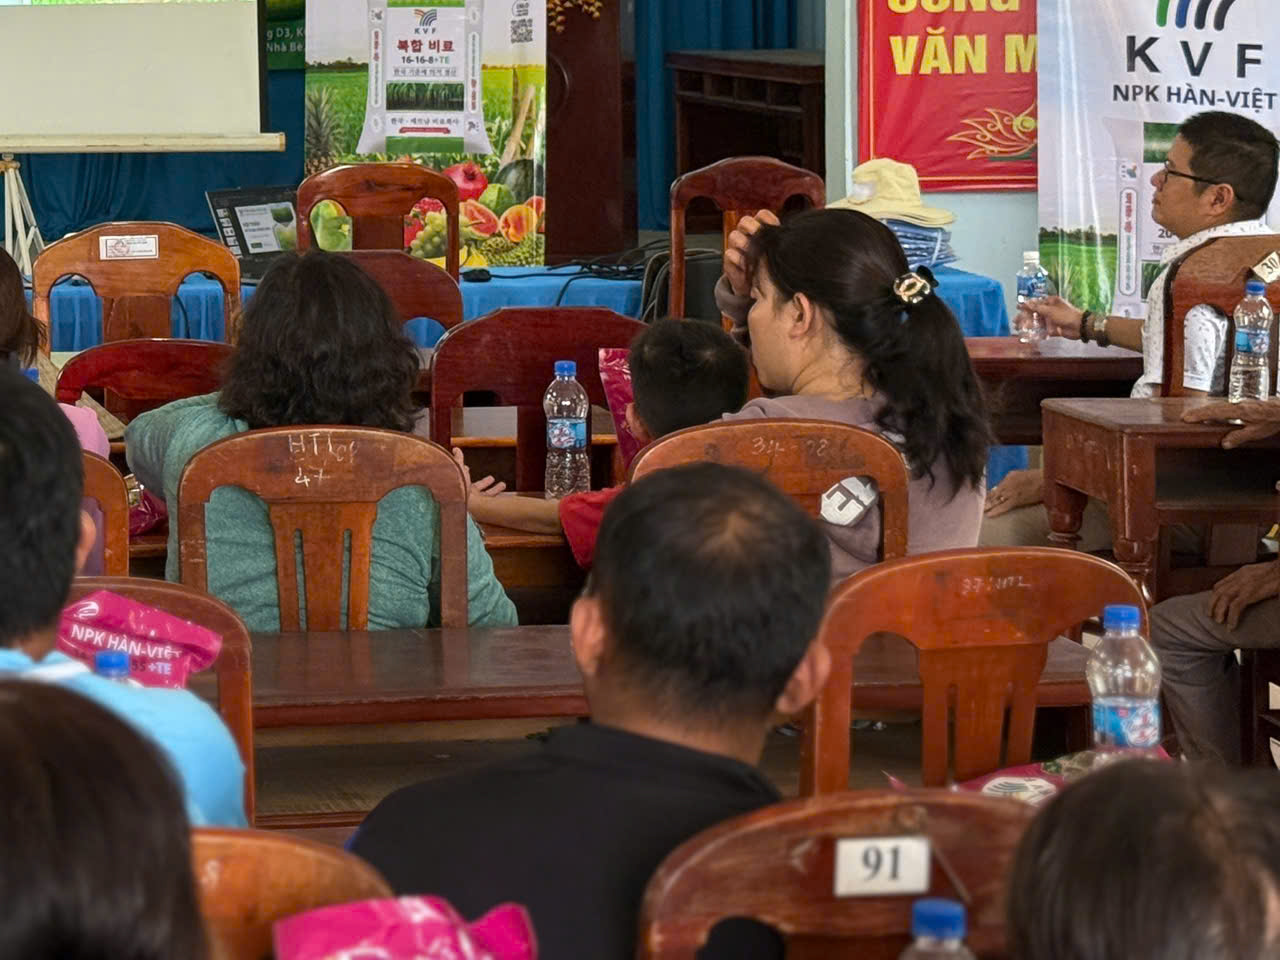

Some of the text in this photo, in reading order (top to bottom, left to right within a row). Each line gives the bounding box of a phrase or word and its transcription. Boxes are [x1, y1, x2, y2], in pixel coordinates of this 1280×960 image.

[888, 27, 989, 76] VĂN
[1112, 83, 1277, 113] NPK HÀN-VIỆT
[1261, 257, 1279, 274] 30
[71, 624, 105, 646] NPK
[862, 846, 900, 881] 91
